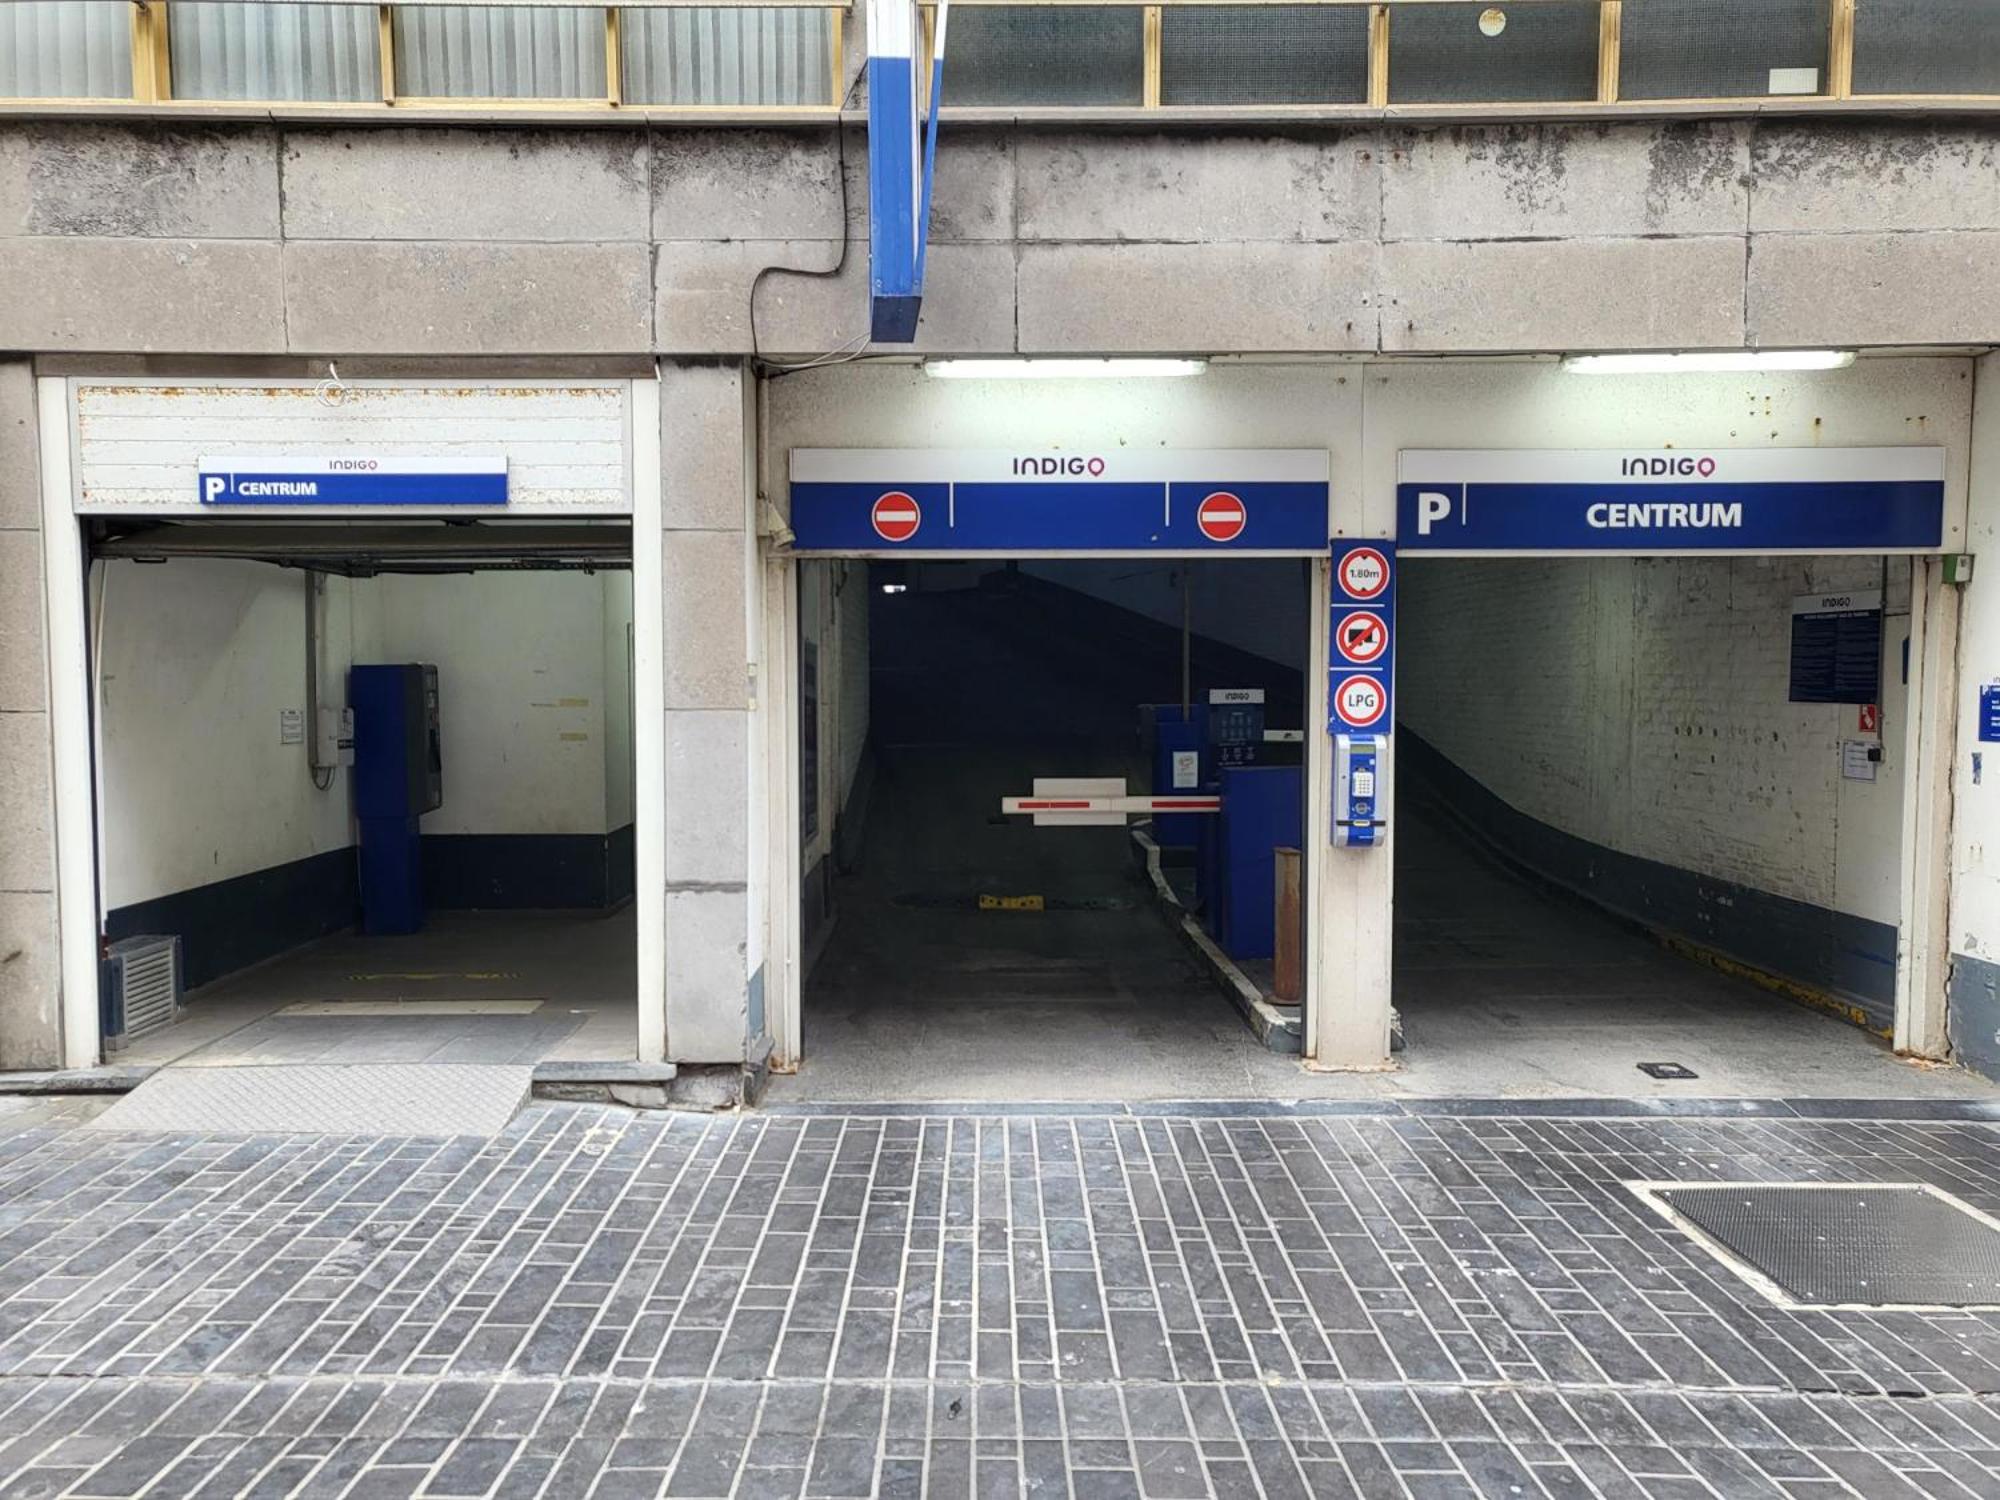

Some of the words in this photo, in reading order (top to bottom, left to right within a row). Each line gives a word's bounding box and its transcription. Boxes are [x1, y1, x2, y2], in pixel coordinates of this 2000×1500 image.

[329, 460, 378, 471] INDIGO
[1013, 457, 1105, 477] INDIGO
[1622, 457, 1715, 478] INDIGO
[205, 477, 226, 502] P
[238, 481, 318, 496] CENTRUM
[1417, 491, 1452, 535] P
[1586, 503, 1743, 528] CENTRUM
[1821, 596, 1852, 608] INDIGO
[1348, 694, 1376, 708] LPG
